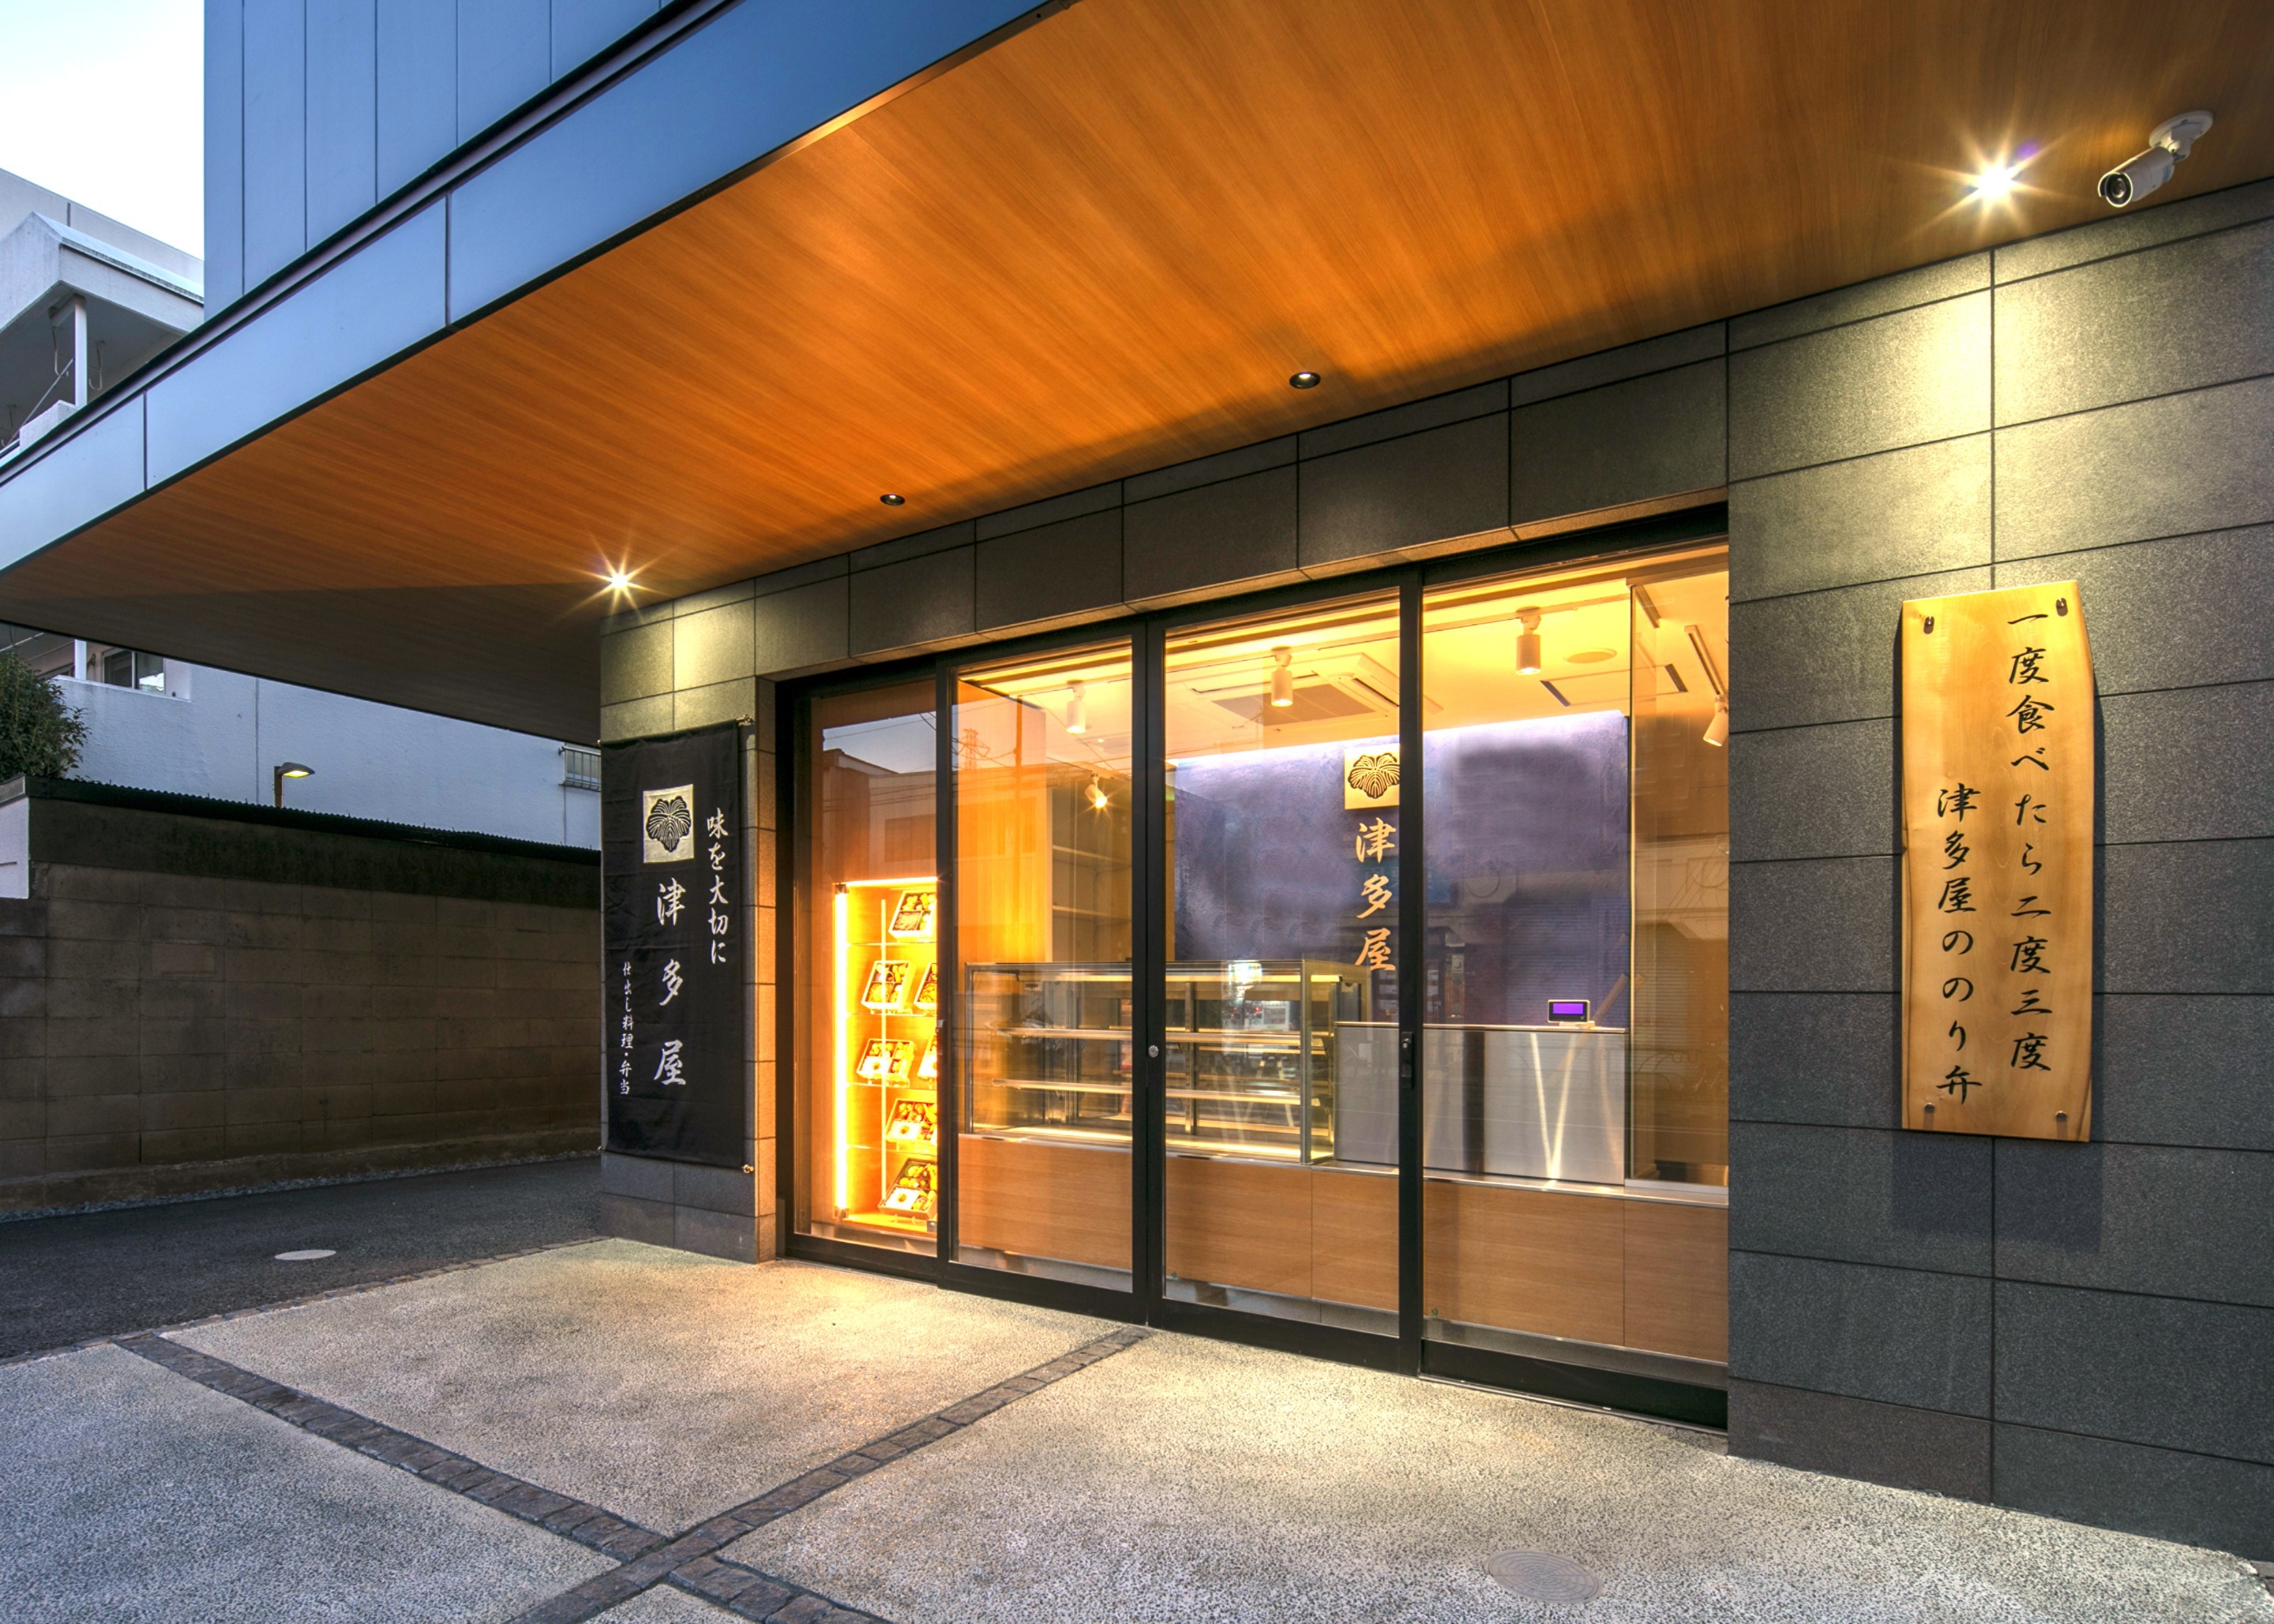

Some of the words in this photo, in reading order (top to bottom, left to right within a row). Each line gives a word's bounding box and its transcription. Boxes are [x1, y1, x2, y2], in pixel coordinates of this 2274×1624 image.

[707, 807, 730, 965] 味を大切に
[1355, 817, 1396, 970] 津多屋
[1935, 782, 1982, 1105] 津多屋ののり弁
[2006, 613, 2054, 1071] 一度食べたら二度三度
[654, 877, 686, 1086] 津多屋
